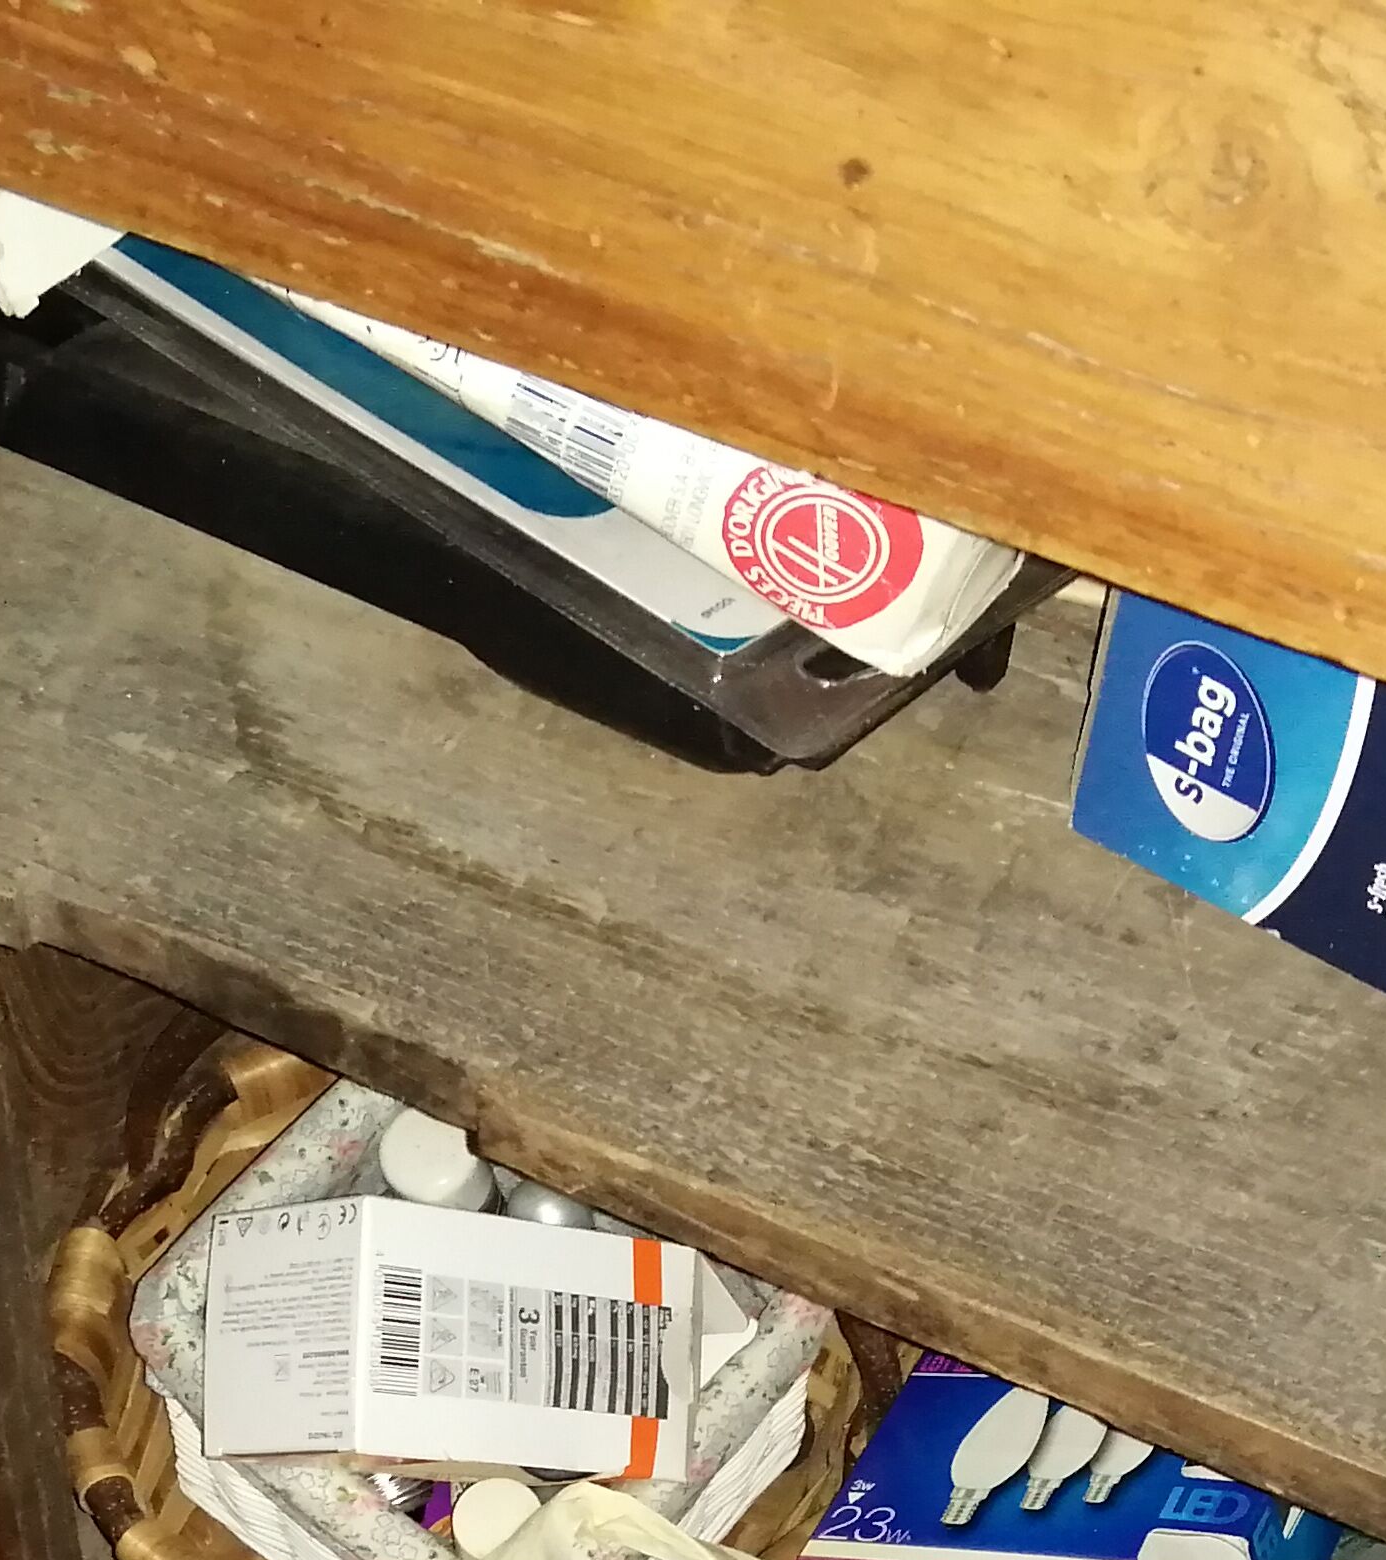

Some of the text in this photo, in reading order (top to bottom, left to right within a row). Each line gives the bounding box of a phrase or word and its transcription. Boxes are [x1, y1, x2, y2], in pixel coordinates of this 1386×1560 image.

[1173, 674, 1238, 805] s-bag
[1221, 712, 1250, 788] THE ORIGINAL
[517, 1306, 541, 1326] 3
[1157, 1486, 1251, 1525] LED
